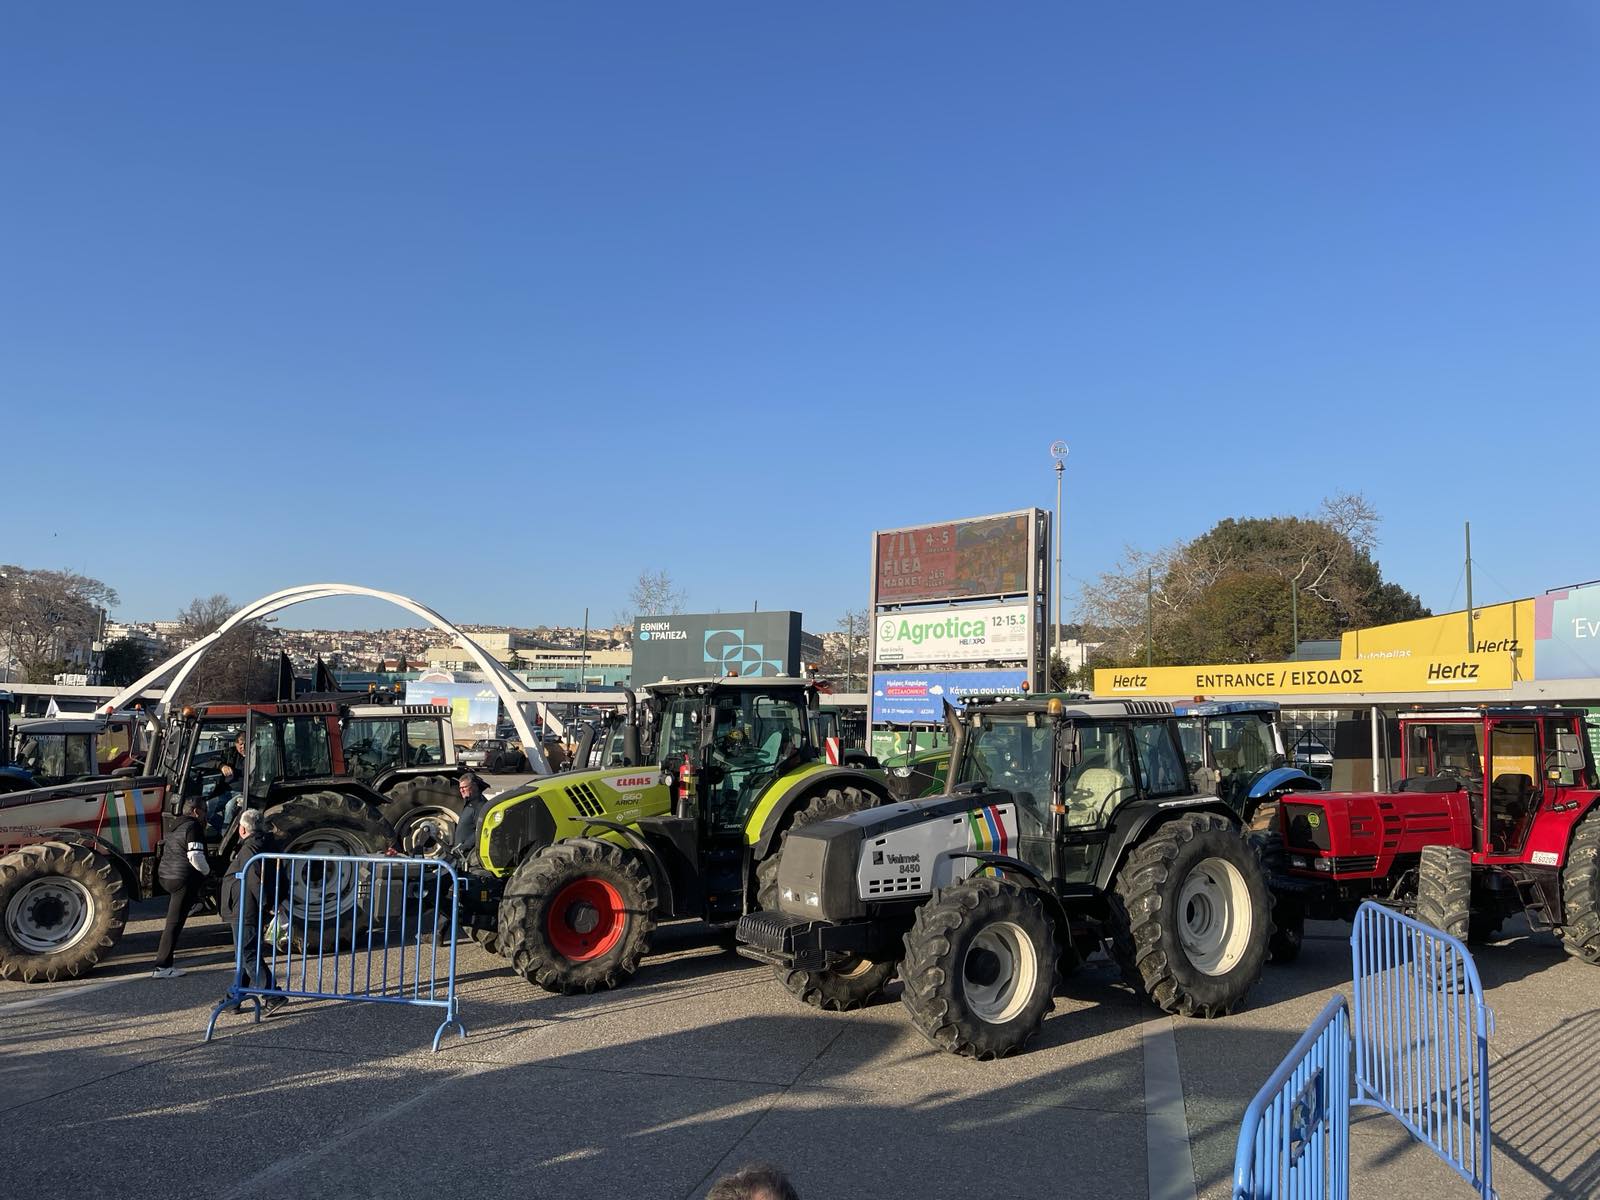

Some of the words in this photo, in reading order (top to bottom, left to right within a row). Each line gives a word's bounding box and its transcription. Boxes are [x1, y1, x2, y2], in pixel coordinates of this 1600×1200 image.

[883, 557, 921, 576] FLEA
[883, 576, 921, 588] MARKET
[640, 622, 670, 631] ΕΘΝΙΚΗ
[897, 617, 985, 645] Agrotica
[650, 631, 687, 640] ΤΡΑΠΕΖΑ
[1476, 638, 1518, 653] Hertz
[1428, 662, 1480, 679] Hertz
[1113, 674, 1147, 688] Hertz
[1196, 672, 1275, 688] ENTRANCE
[1279, 671, 1287, 688] /
[1292, 669, 1363, 686] ΕΙΣΟΔΟΣ
[950, 686, 967, 695] Κάνε
[970, 687, 979, 695] να
[981, 687, 995, 695] σου
[616, 777, 651, 787] CLAAS
[886, 853, 920, 864] Valmet
[899, 864, 921, 873] 8450
